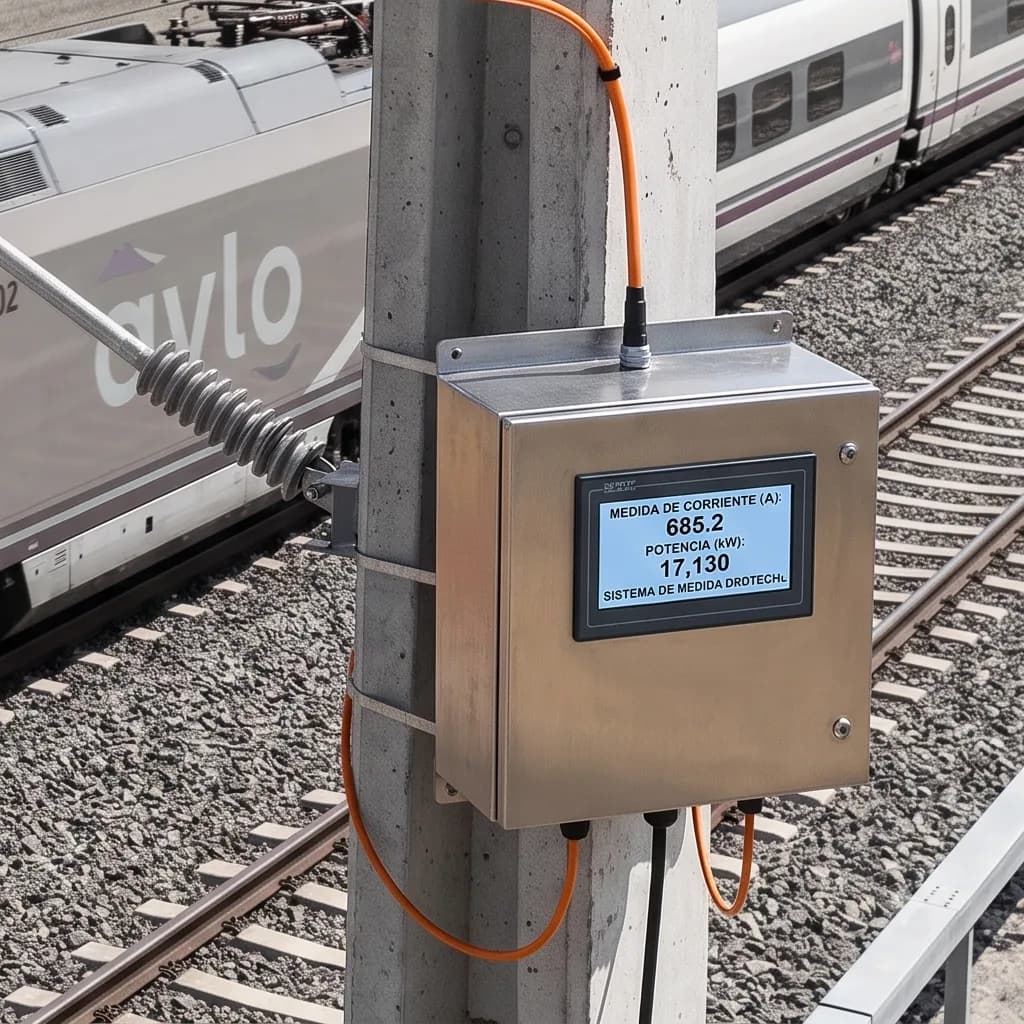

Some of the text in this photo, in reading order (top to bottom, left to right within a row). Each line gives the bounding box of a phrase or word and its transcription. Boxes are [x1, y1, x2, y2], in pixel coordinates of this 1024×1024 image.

[609, 492, 782, 519] MEDIDA DE CORRIENTE (A):
[666, 513, 724, 537] 685.2
[645, 536, 745, 557] POTENCIA (kW):
[660, 553, 730, 579] 17,130
[603, 588, 656, 602] SISTEMA
[658, 584, 675, 596] DE
[677, 579, 723, 594] MEDIDA
